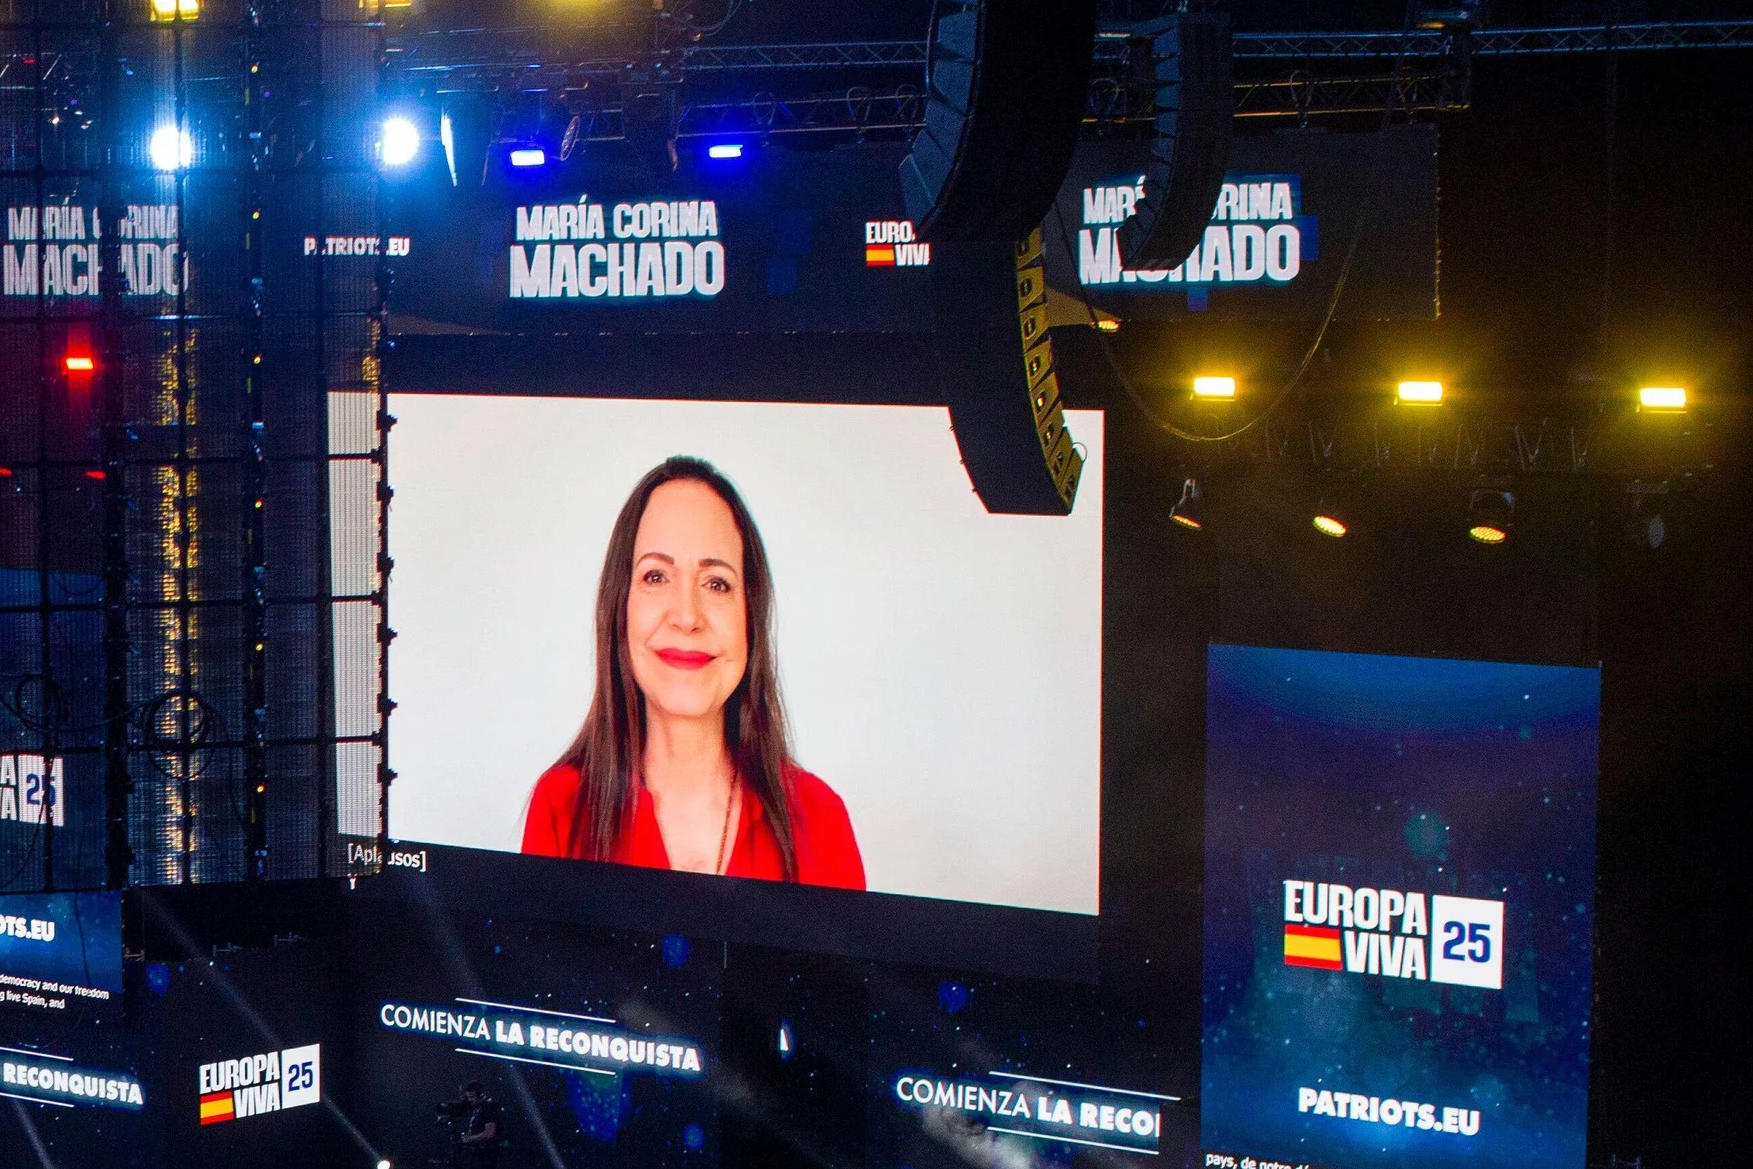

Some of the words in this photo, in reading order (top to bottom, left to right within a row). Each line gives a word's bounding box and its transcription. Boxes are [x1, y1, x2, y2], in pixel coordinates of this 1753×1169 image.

[516, 193, 605, 241] MARÍA
[613, 200, 718, 239] CORINA
[1211, 182, 1293, 220] RINA
[510, 240, 725, 298] MACHADO
[1283, 880, 1427, 936] EUROPA
[1443, 920, 1491, 963] 25
[1344, 930, 1427, 980] VIVA
[22, 992, 47, 1008] Spain,
[49, 999, 65, 1010] and
[42, 980, 58, 992] and
[59, 983, 74, 994] our
[381, 1004, 491, 1041] COMIENZA
[495, 1020, 525, 1046] LA
[530, 1025, 701, 1071] RECONQUISTA
[3, 1062, 144, 1105] RECONQUISTA
[200, 1051, 280, 1094] EUROPA
[288, 1061, 314, 1092] 25
[234, 1082, 281, 1119] VIVA
[896, 1077, 1031, 1119] COMIENZA
[1037, 1097, 1073, 1125] LA
[1298, 1087, 1480, 1136] PATRIOTS.EU
